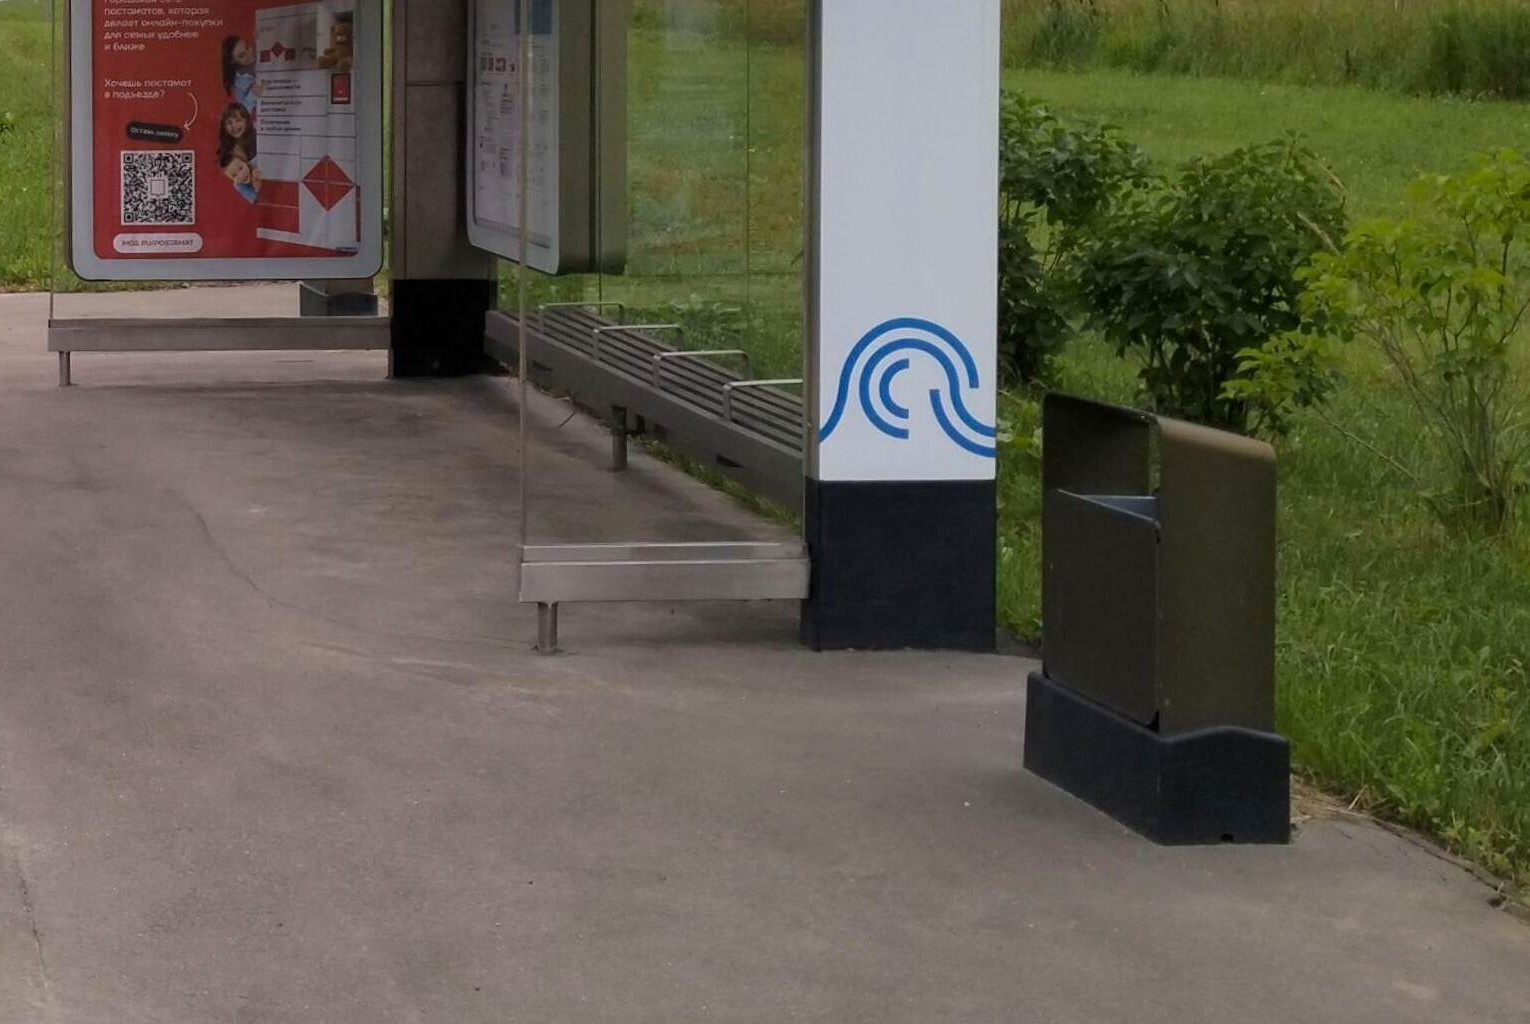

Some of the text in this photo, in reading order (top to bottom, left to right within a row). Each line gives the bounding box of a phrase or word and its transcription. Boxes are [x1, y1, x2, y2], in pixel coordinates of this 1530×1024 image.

[168, 7, 210, 17] которая
[104, 78, 192, 88] Хочешь постамат
